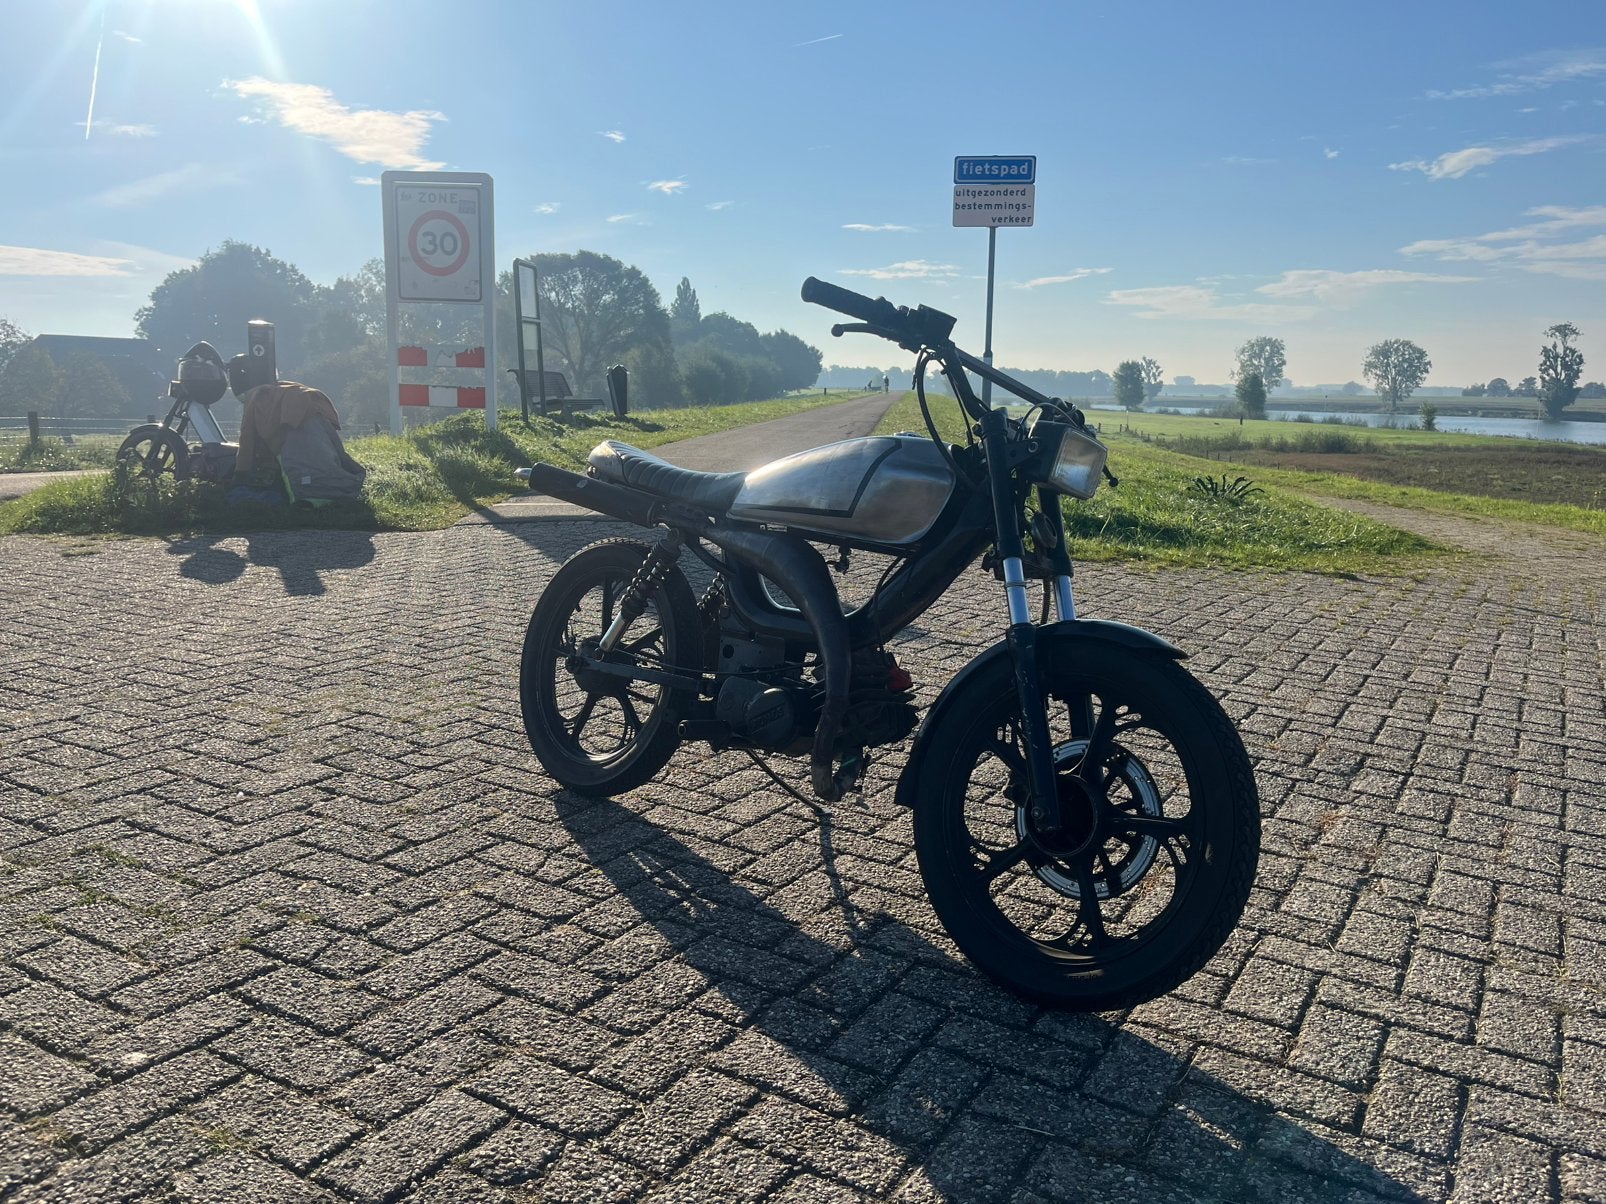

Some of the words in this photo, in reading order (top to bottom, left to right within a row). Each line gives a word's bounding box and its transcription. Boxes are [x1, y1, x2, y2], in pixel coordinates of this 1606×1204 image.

[962, 162, 1028, 177] fietspad
[418, 192, 458, 204] ZONE
[955, 188, 1026, 198] uitgezonderd
[955, 202, 1032, 211] bestemmings-
[991, 215, 1032, 223] verkeer
[420, 231, 458, 256] 30
